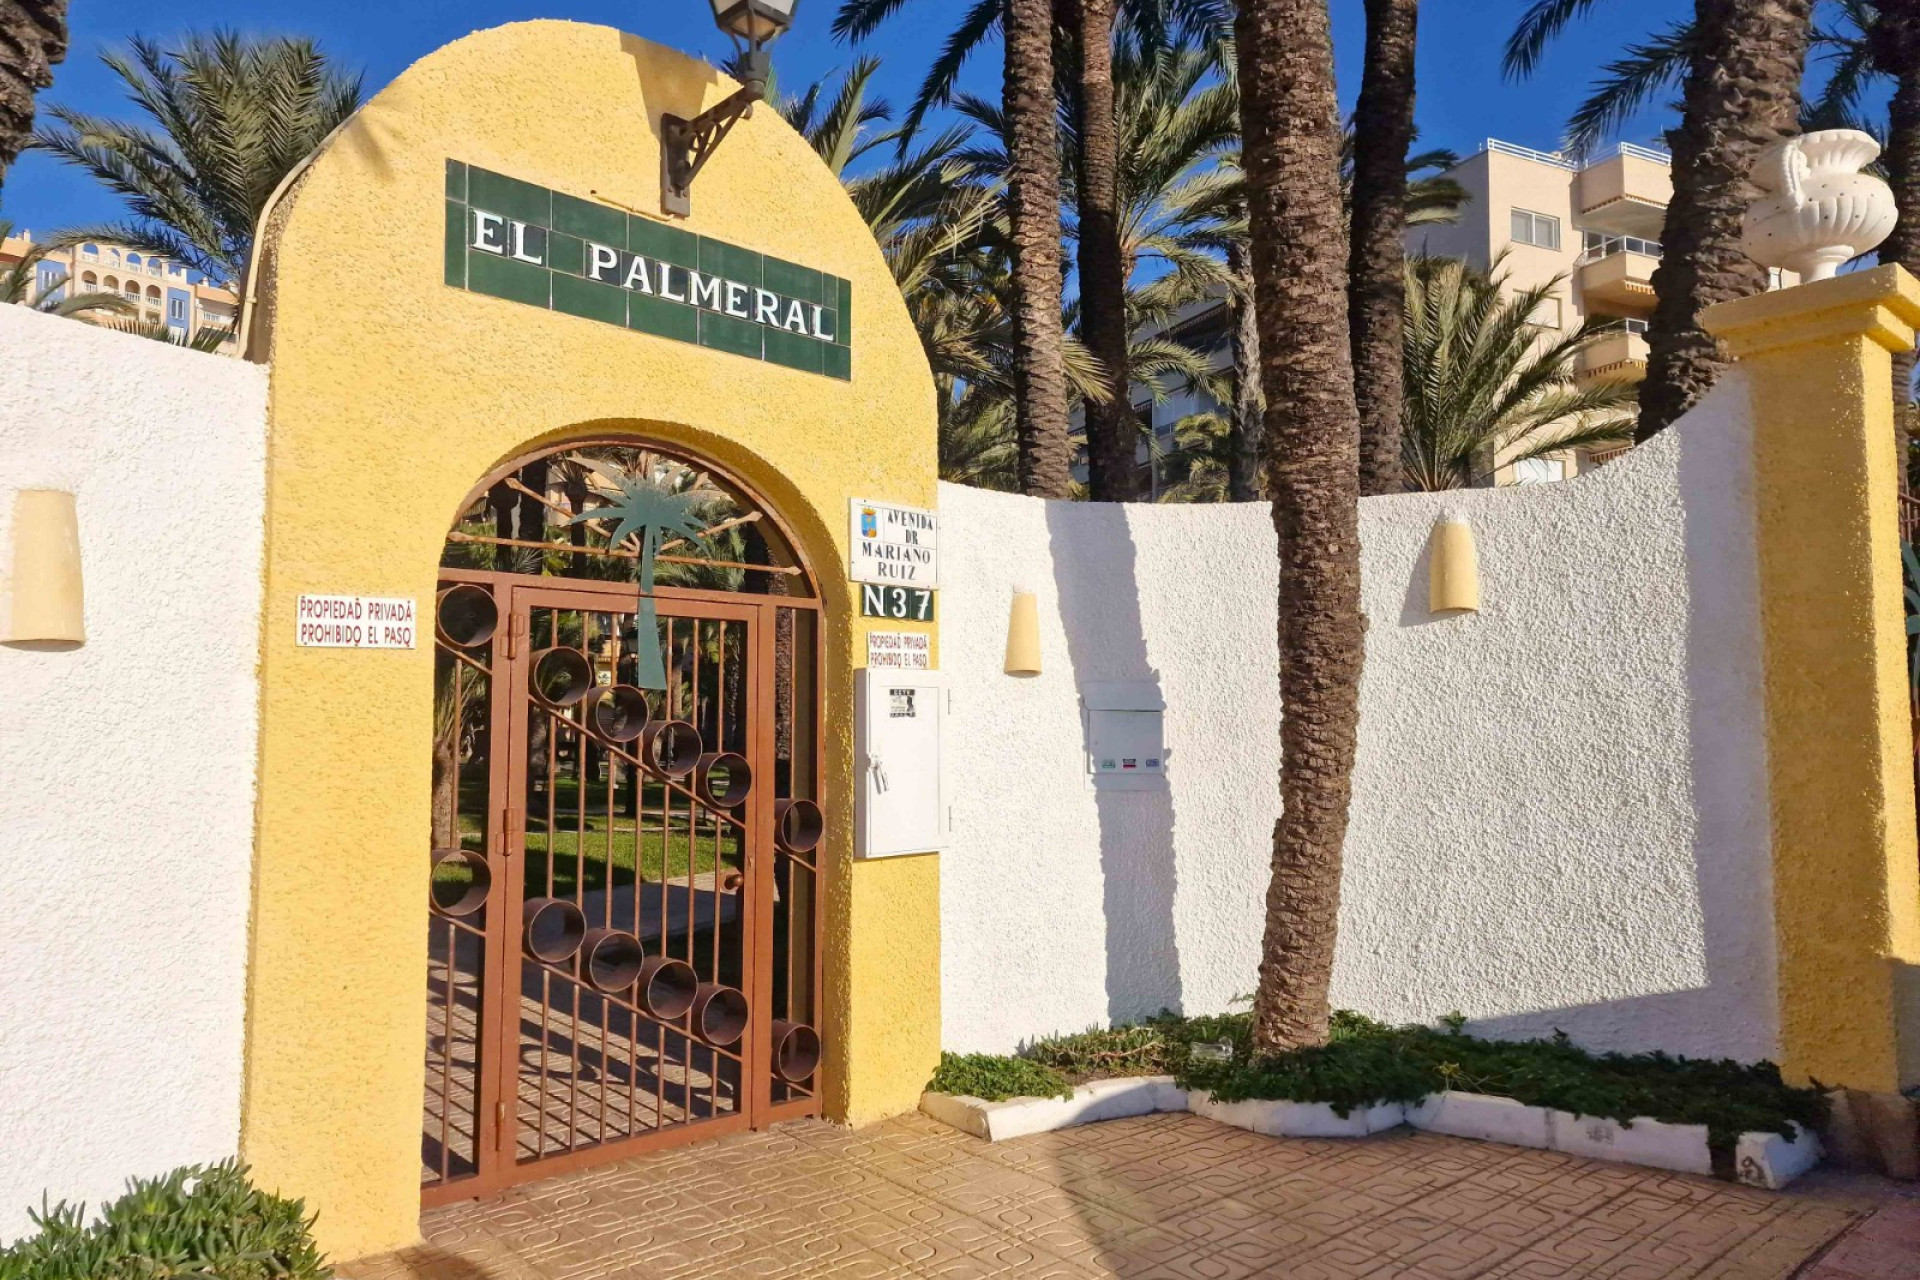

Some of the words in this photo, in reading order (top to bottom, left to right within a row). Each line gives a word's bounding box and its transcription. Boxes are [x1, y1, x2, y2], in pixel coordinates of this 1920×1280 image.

[472, 208, 542, 265] EL
[588, 243, 833, 341] PALMERAL
[887, 509, 933, 530] AVENIDA
[905, 529, 918, 545] DR
[862, 542, 931, 564] MARIANO
[878, 562, 916, 580] RUIZ
[300, 599, 362, 619] PROPIEDAD
[368, 603, 412, 622] PRIVADA
[301, 624, 361, 643] PROHIBIDO
[368, 626, 378, 644] EL
[385, 627, 411, 645] PASO
[870, 634, 901, 649] PROPIEDAD
[904, 636, 927, 649] PRIVADA
[870, 652, 901, 665] PROHIBIDO
[904, 653, 911, 666] EL
[913, 653, 927, 666] PASO
